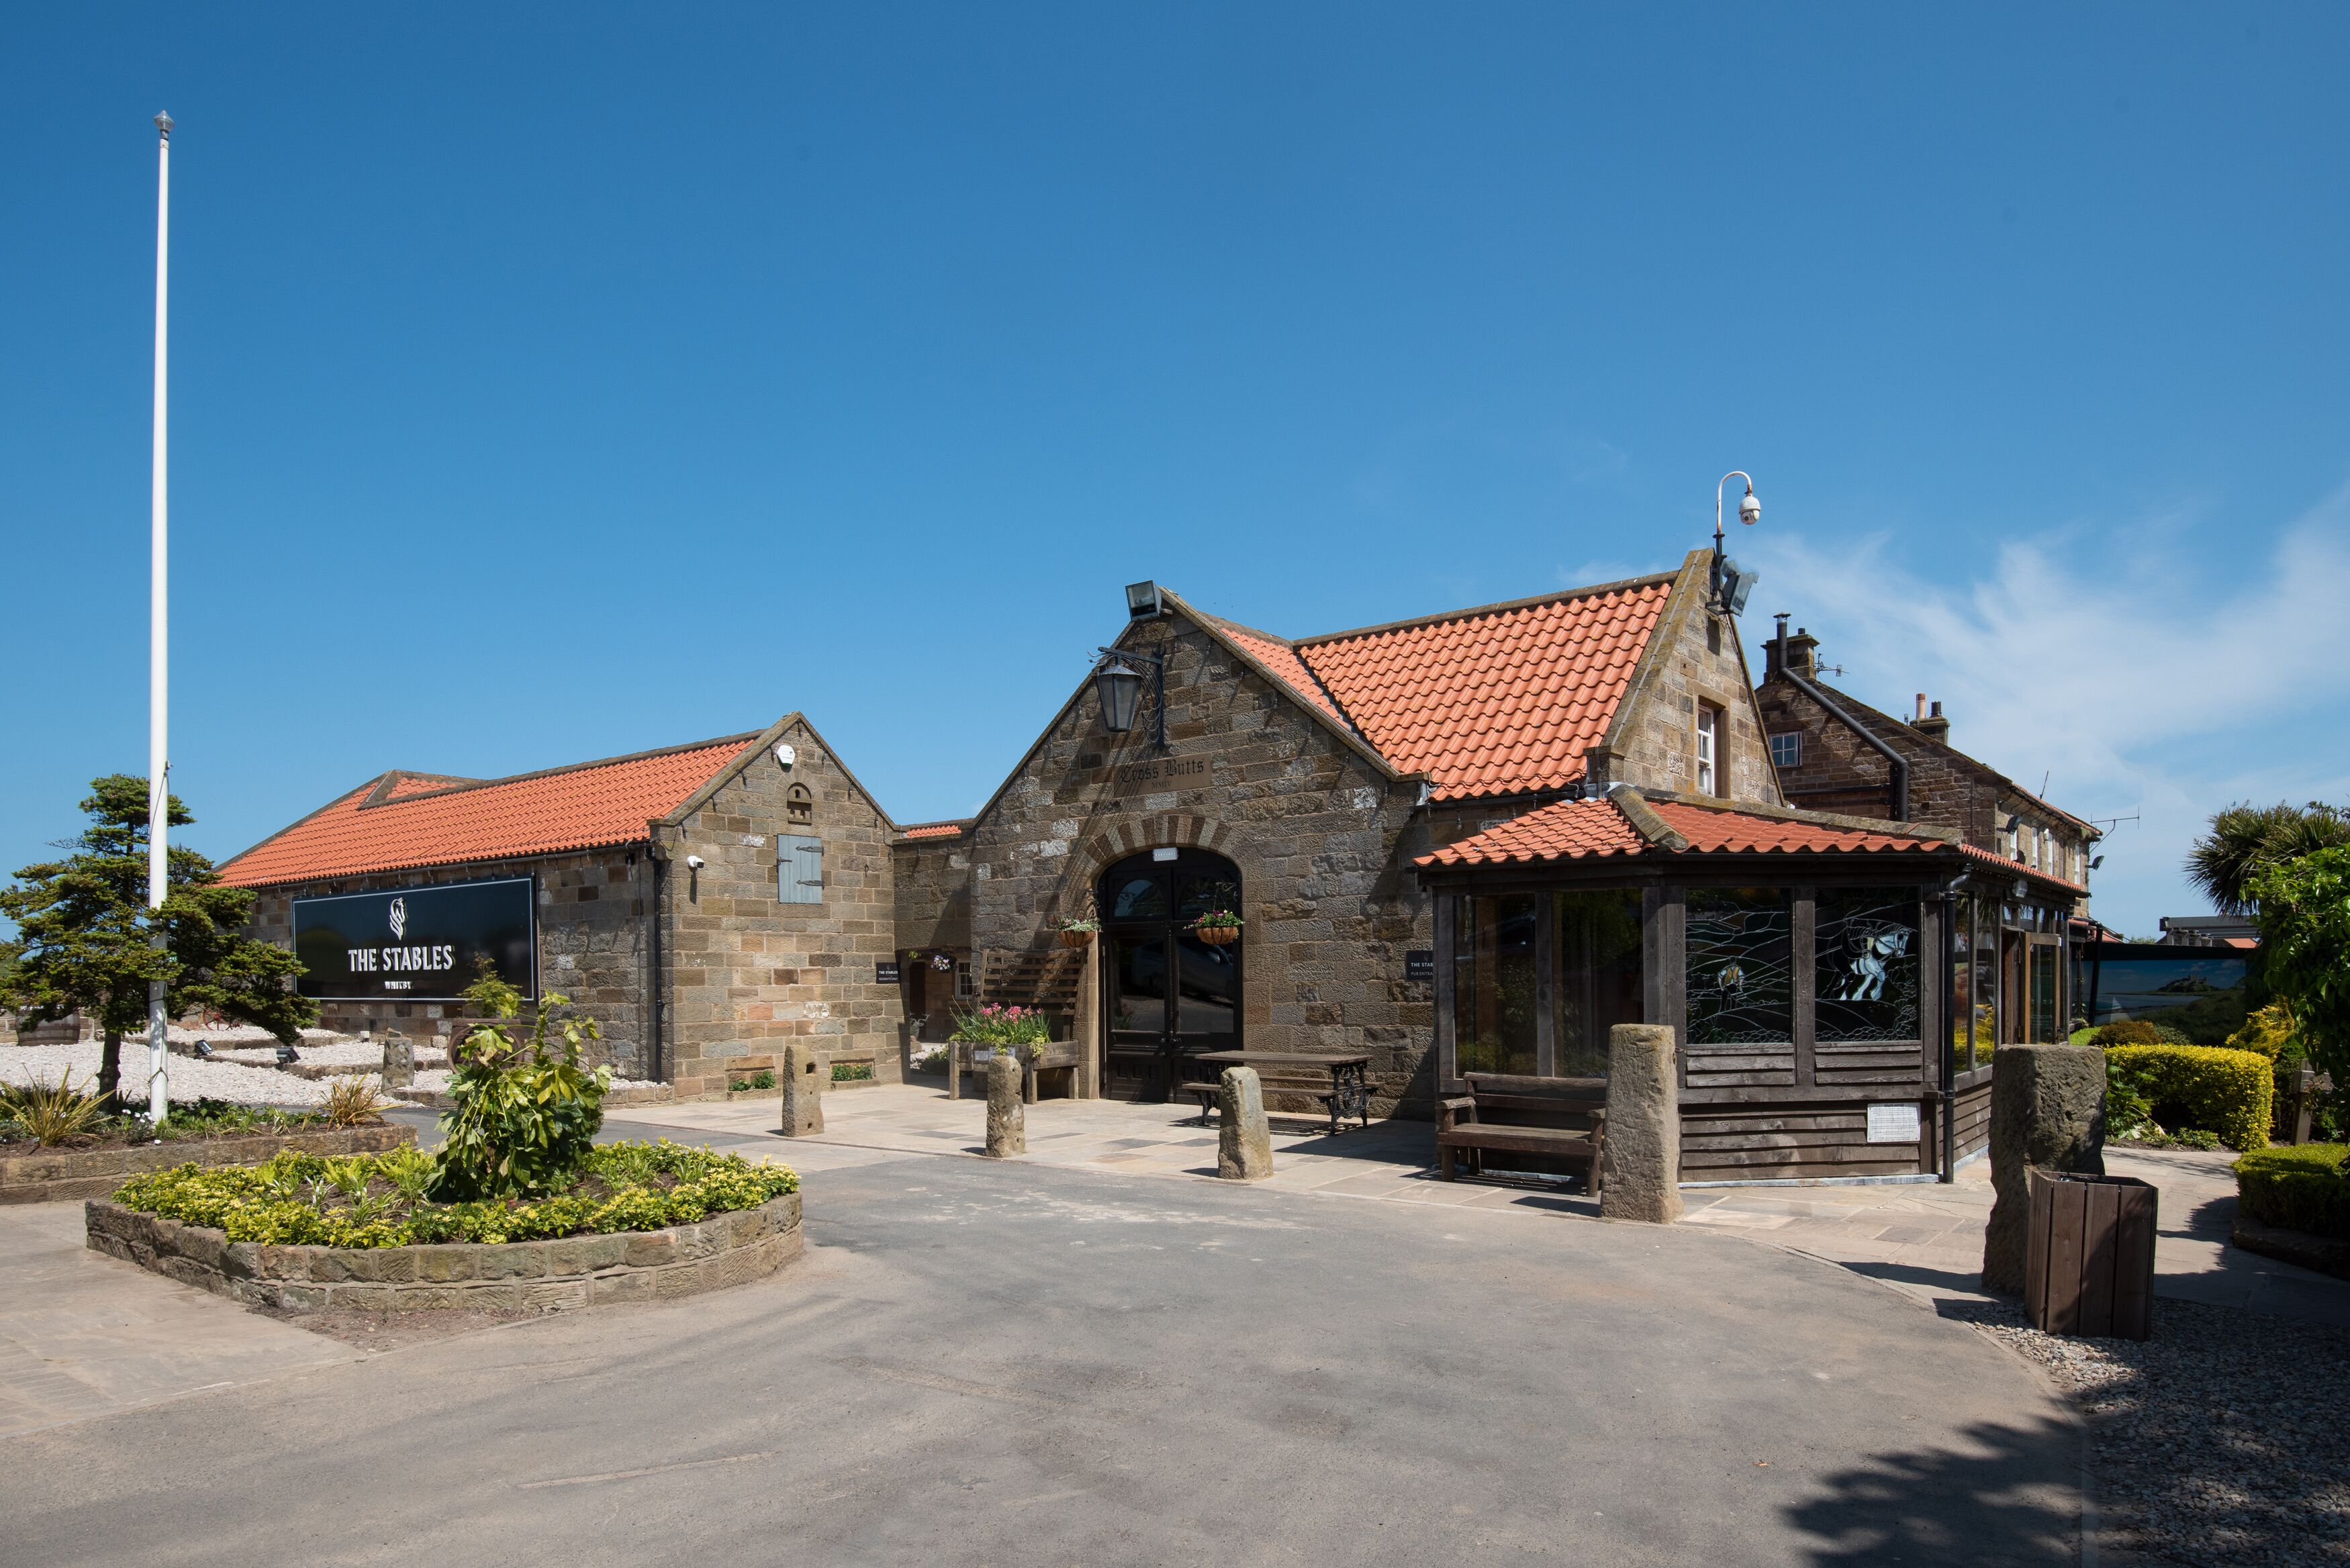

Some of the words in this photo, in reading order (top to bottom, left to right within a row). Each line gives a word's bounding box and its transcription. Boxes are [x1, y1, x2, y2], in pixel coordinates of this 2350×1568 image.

[1121, 766, 1159, 783] Cross
[1164, 758, 1204, 777] Butts
[348, 948, 377, 972] THE
[383, 945, 453, 971] STABLES
[385, 981, 413, 989] WHITBY
